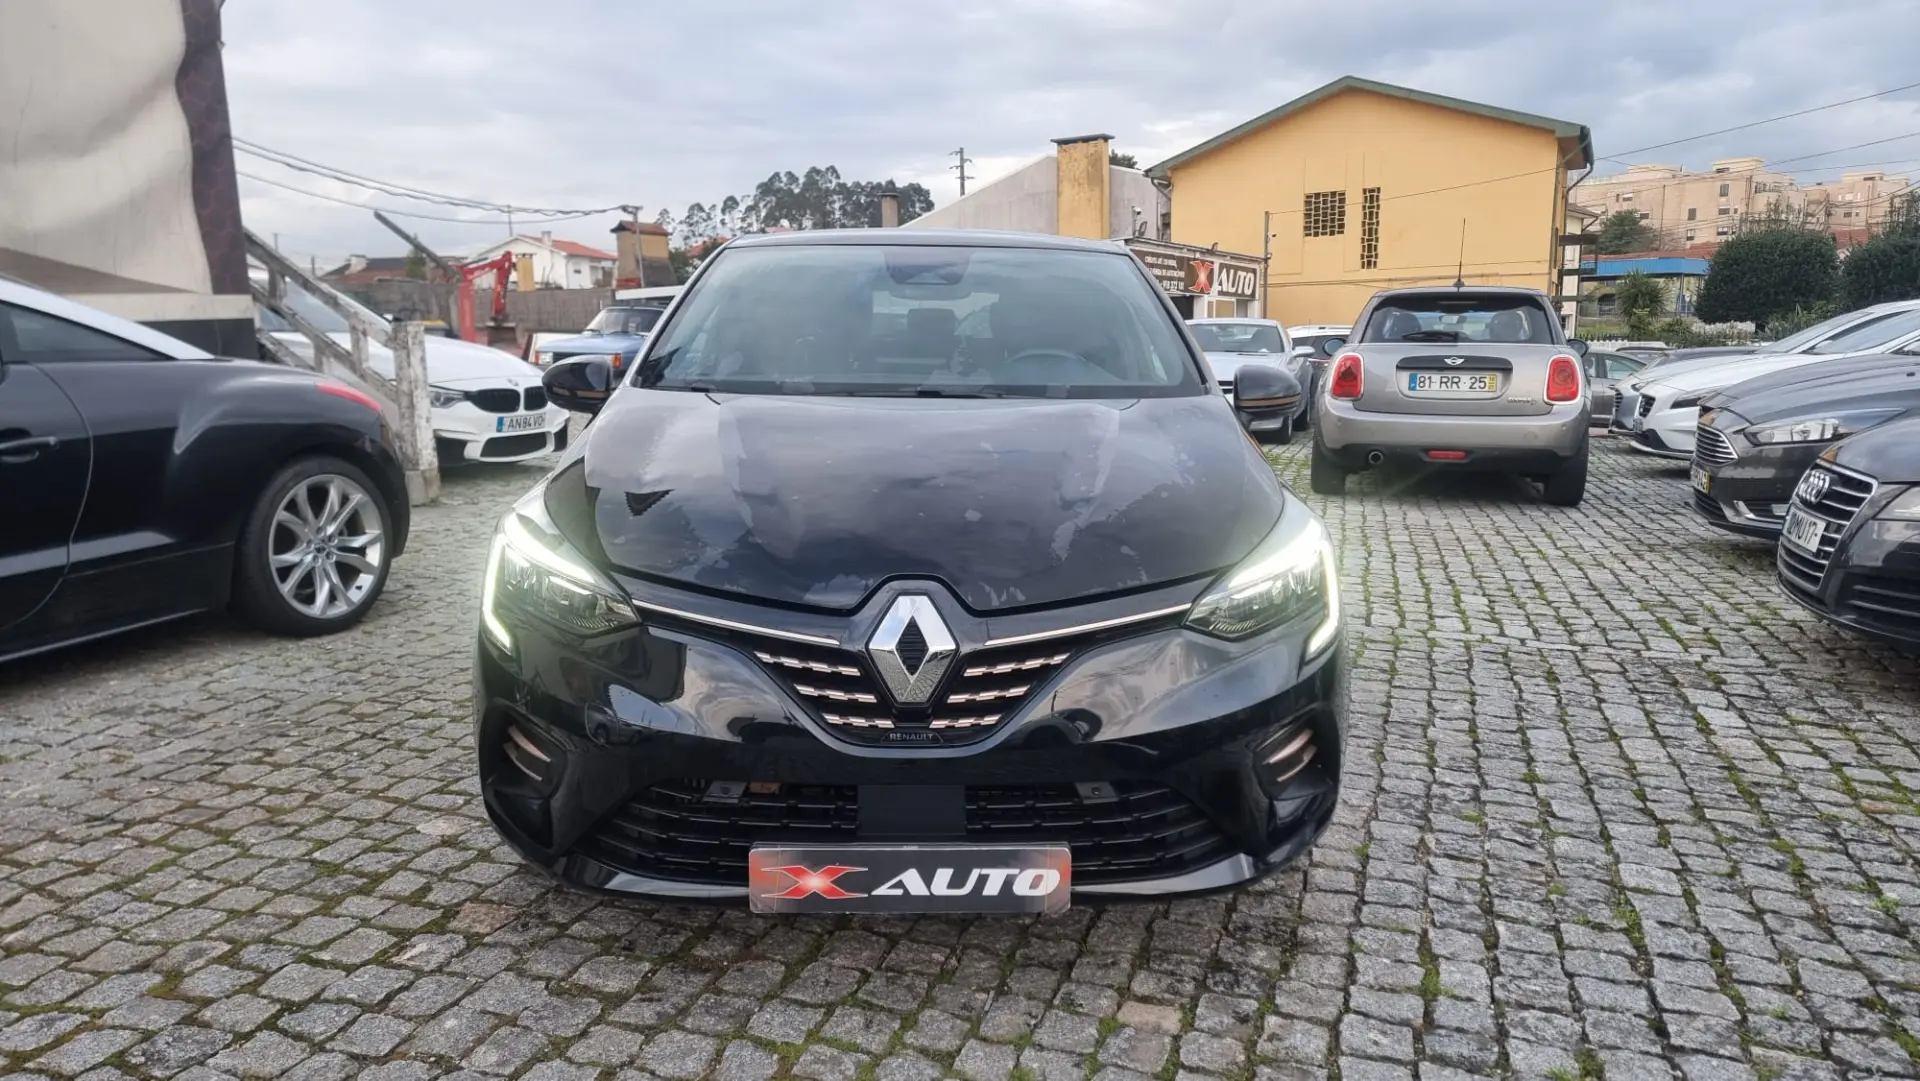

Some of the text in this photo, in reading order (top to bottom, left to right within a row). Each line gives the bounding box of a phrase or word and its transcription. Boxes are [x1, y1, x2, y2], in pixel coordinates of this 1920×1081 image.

[1217, 268, 1254, 295] AUTO
[889, 733, 934, 741] RENAULT
[761, 865, 1060, 899] X AUTO
